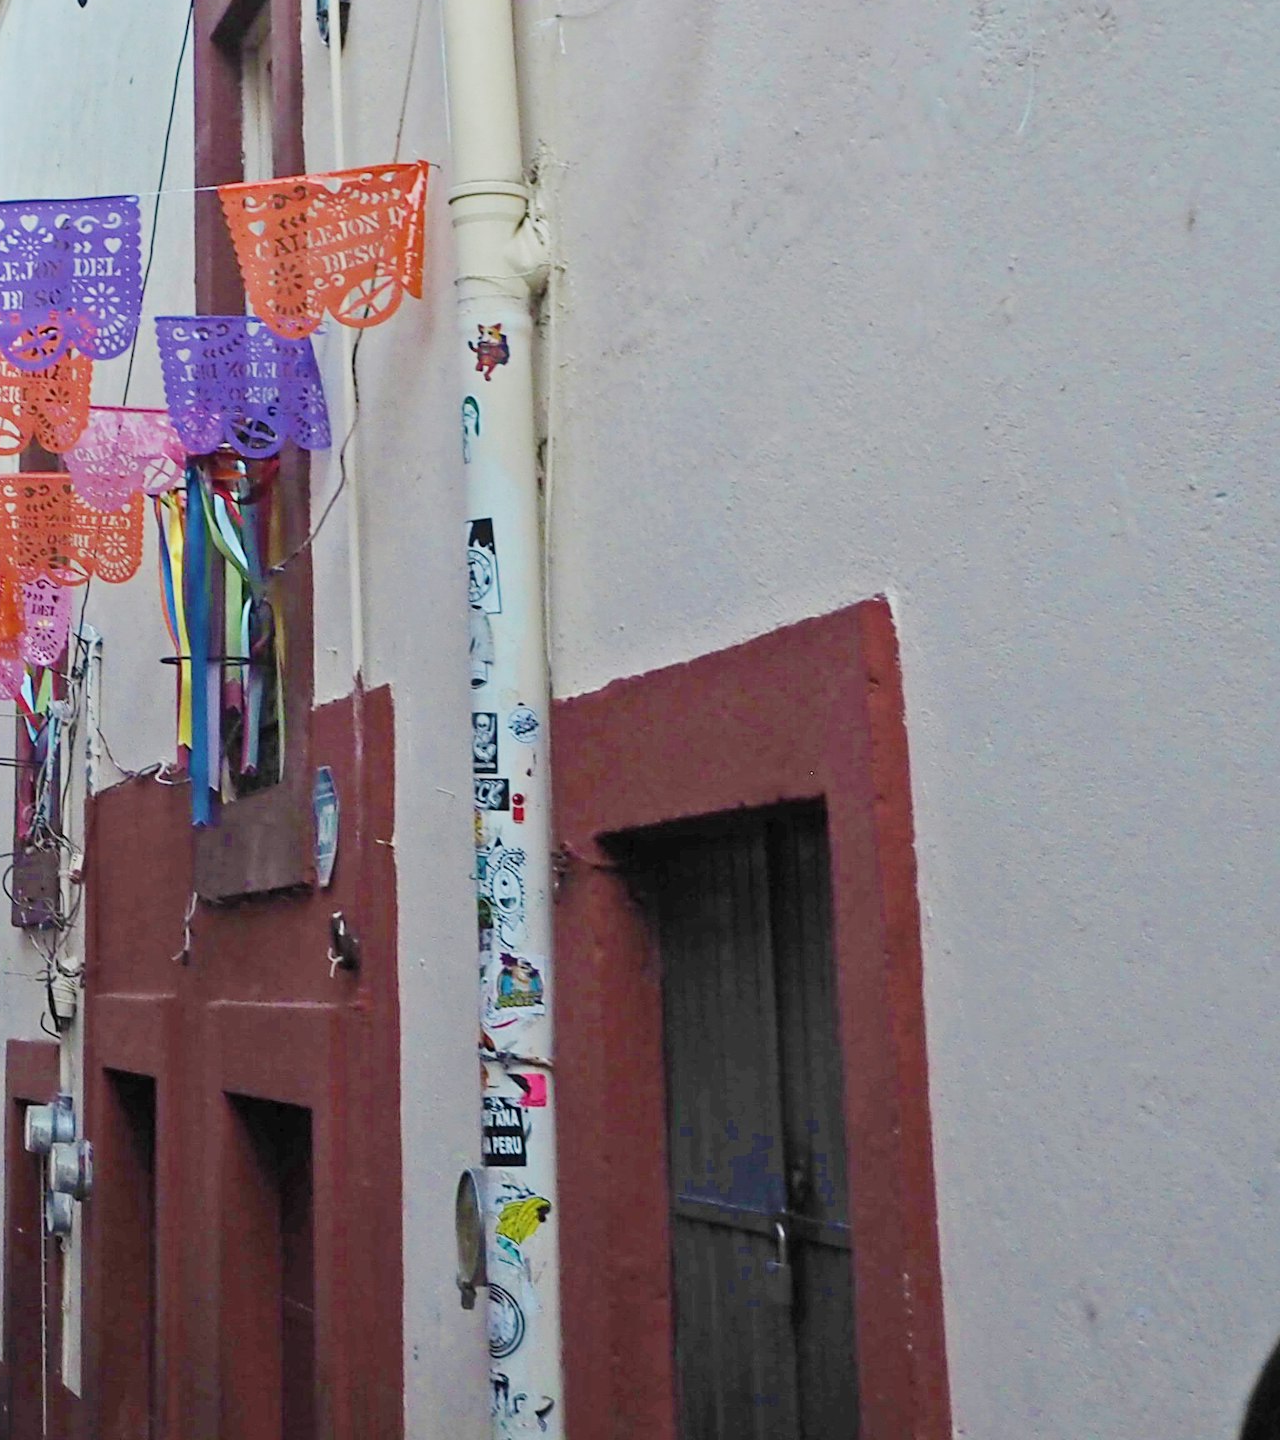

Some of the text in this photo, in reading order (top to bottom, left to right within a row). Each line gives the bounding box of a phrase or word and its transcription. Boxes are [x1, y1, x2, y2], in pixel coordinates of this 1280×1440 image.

[255, 210, 380, 260] CALLEJON
[72, 256, 121, 278] DEL
[492, 1136, 522, 1155] PERU
